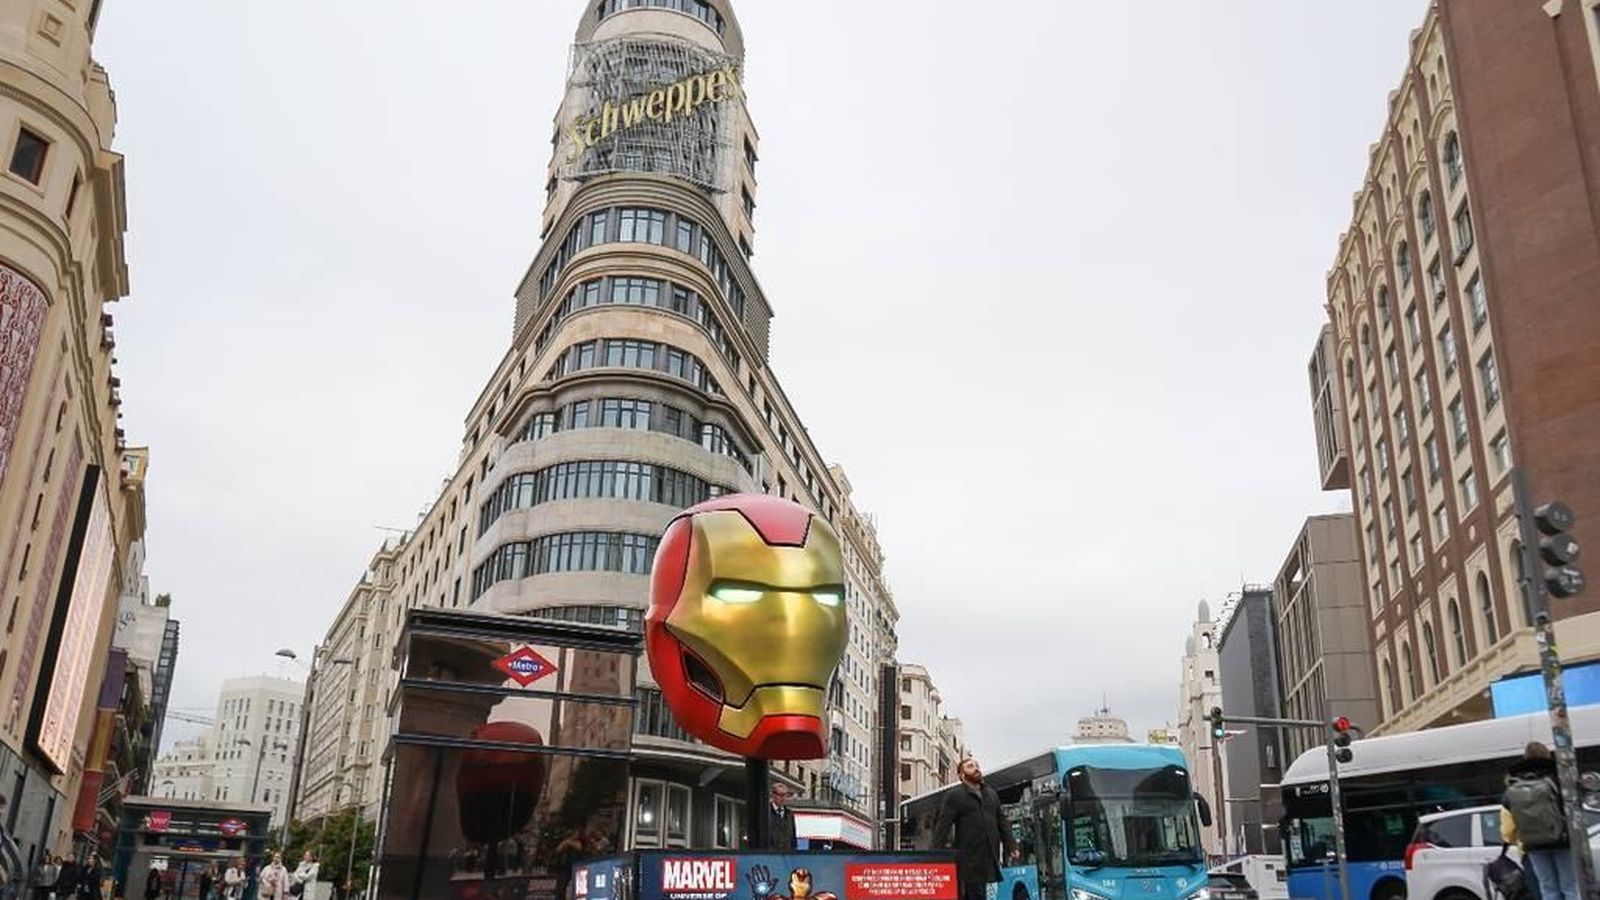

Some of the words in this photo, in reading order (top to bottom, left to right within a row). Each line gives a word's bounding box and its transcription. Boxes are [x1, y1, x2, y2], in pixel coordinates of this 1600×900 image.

[566, 64, 738, 165] Schweppes
[512, 660, 538, 671] Metro
[663, 860, 734, 889] MARVEL
